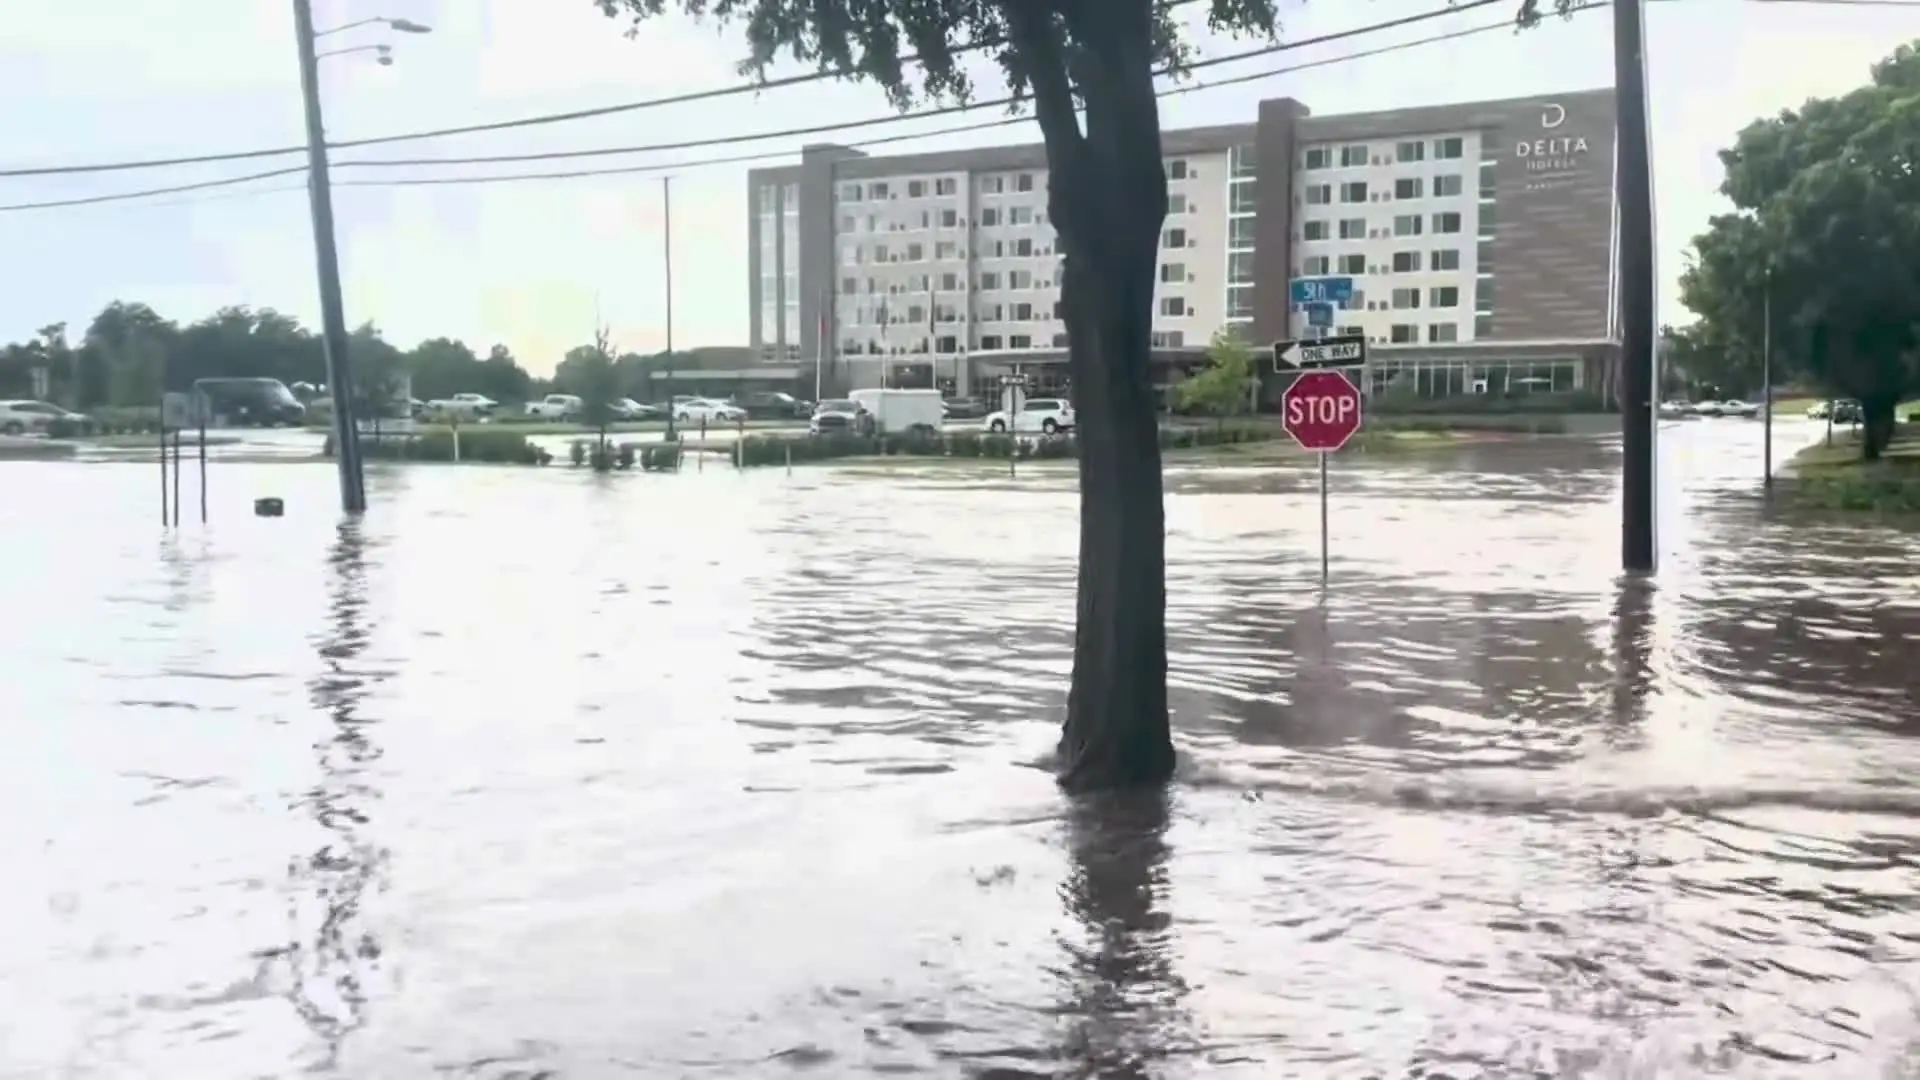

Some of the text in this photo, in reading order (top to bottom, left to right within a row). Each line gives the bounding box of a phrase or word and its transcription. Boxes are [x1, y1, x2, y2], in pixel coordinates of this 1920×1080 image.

[1516, 137, 1588, 157] DELTA
[1302, 343, 1357, 361] ONE WAY
[1288, 395, 1355, 425] STOP
